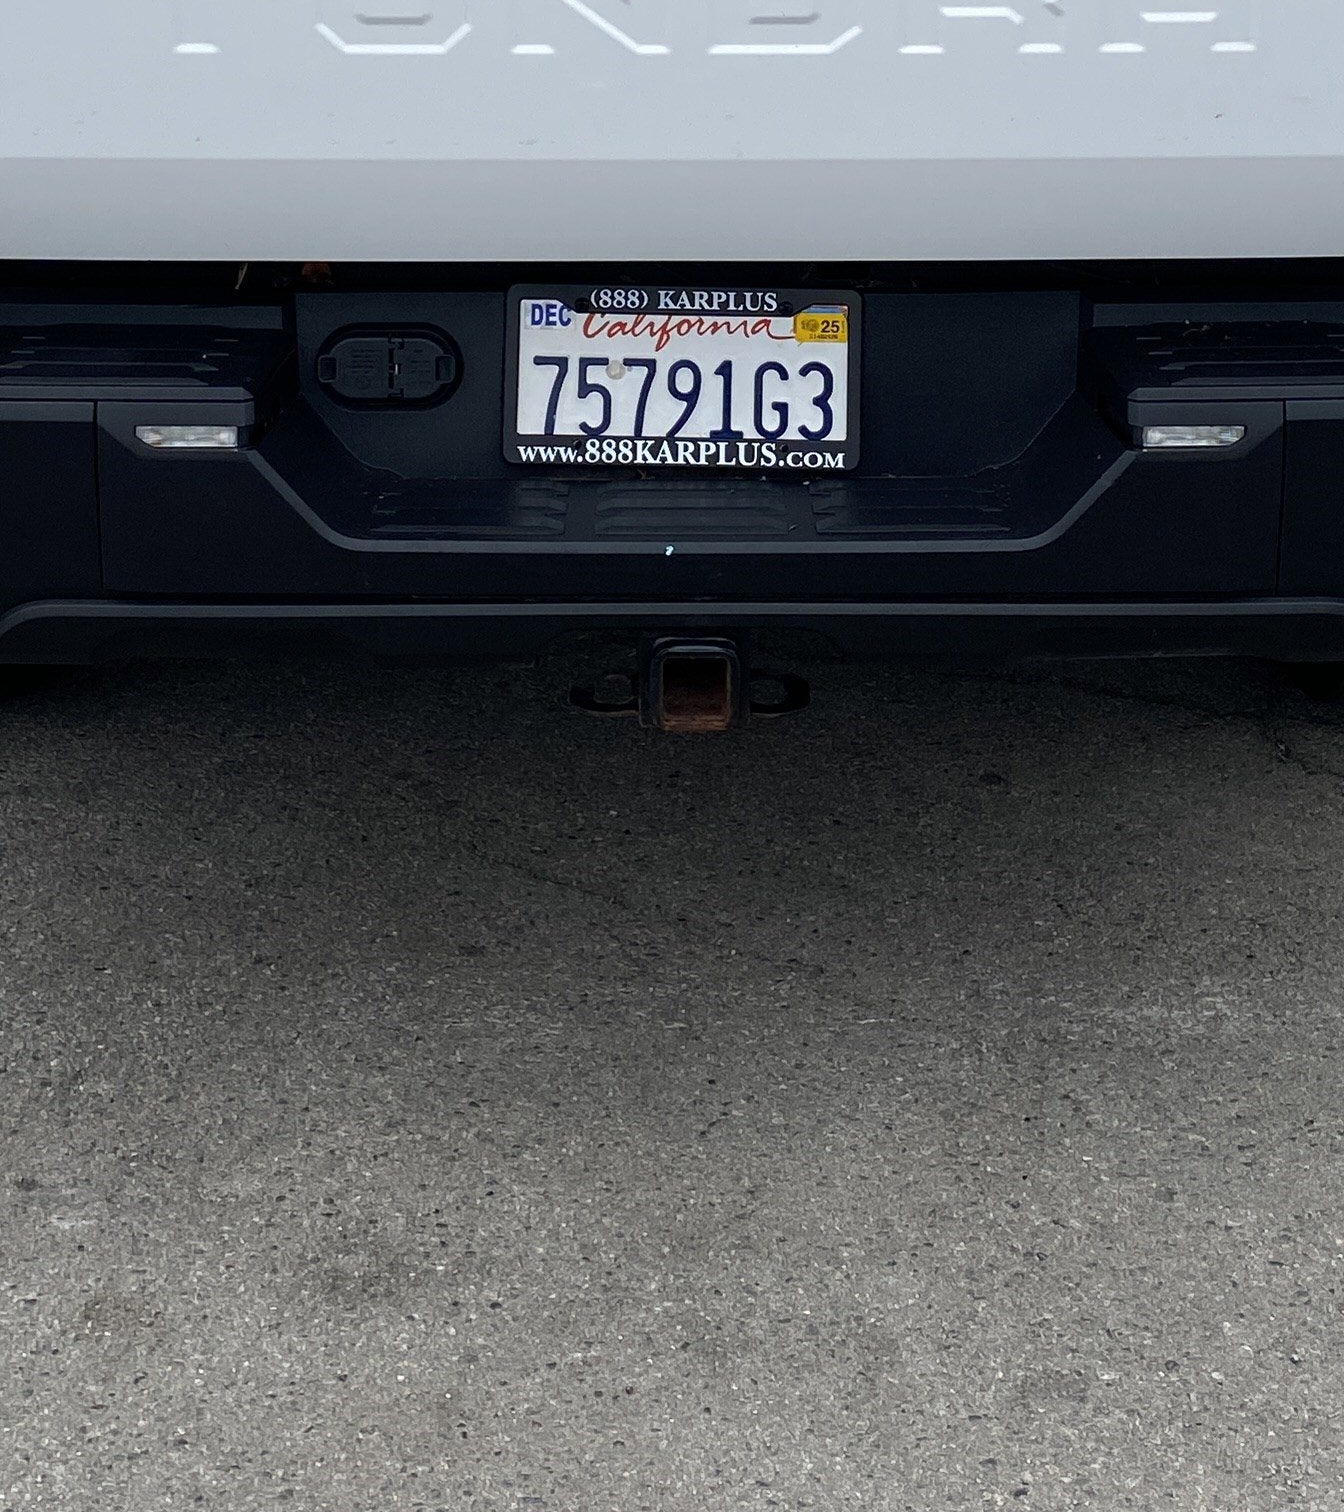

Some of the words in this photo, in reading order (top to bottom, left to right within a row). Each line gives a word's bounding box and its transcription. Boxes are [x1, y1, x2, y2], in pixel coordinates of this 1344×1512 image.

[590, 289, 649, 308] (888)
[658, 290, 778, 312] KARPLUS
[531, 303, 571, 326] DEC
[583, 313, 795, 352] California
[820, 319, 840, 334] 25
[533, 355, 834, 441] 75791G3
